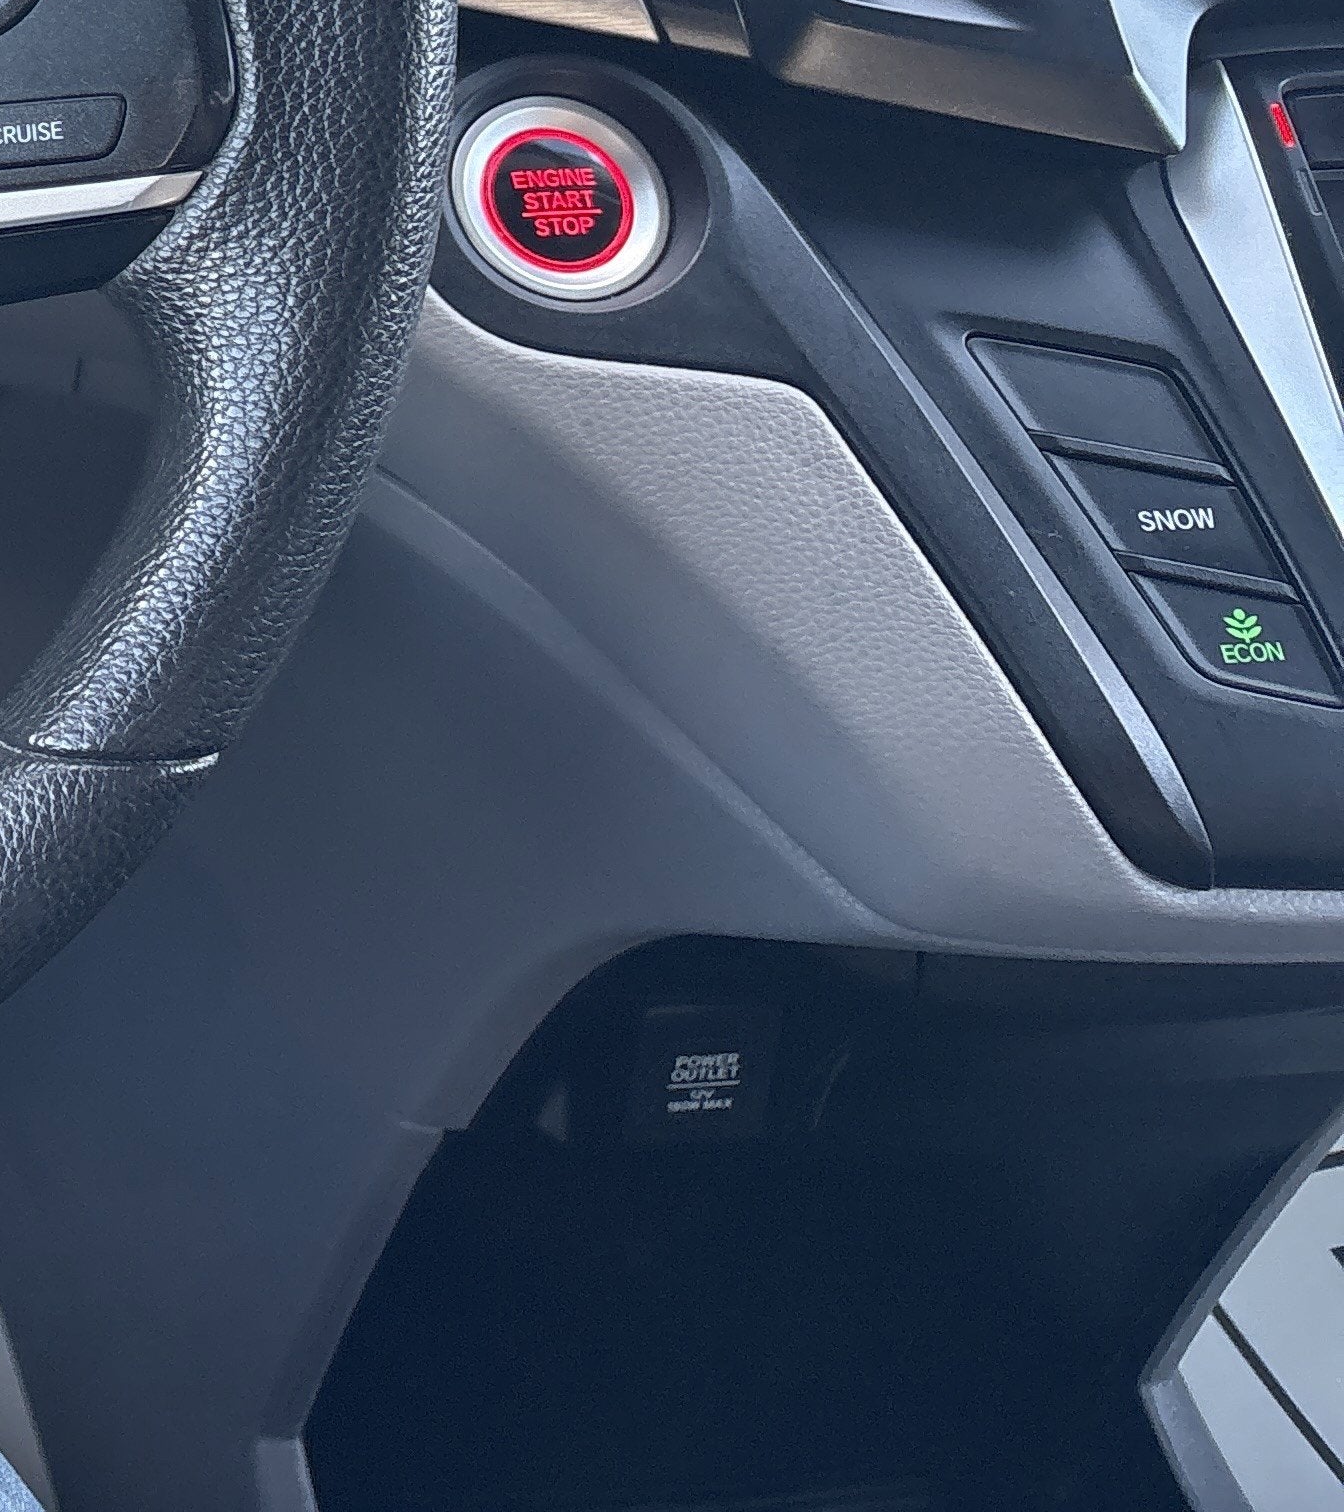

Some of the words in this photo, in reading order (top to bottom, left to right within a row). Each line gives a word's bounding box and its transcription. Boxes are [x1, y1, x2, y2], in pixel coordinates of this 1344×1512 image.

[510, 167, 597, 189] ENGINE
[523, 190, 594, 211] START
[534, 216, 595, 237] STOP
[1137, 507, 1215, 533] SNOW
[1219, 642, 1286, 664] ECON
[675, 1052, 740, 1070] POWER
[671, 1066, 740, 1083] OUTLET
